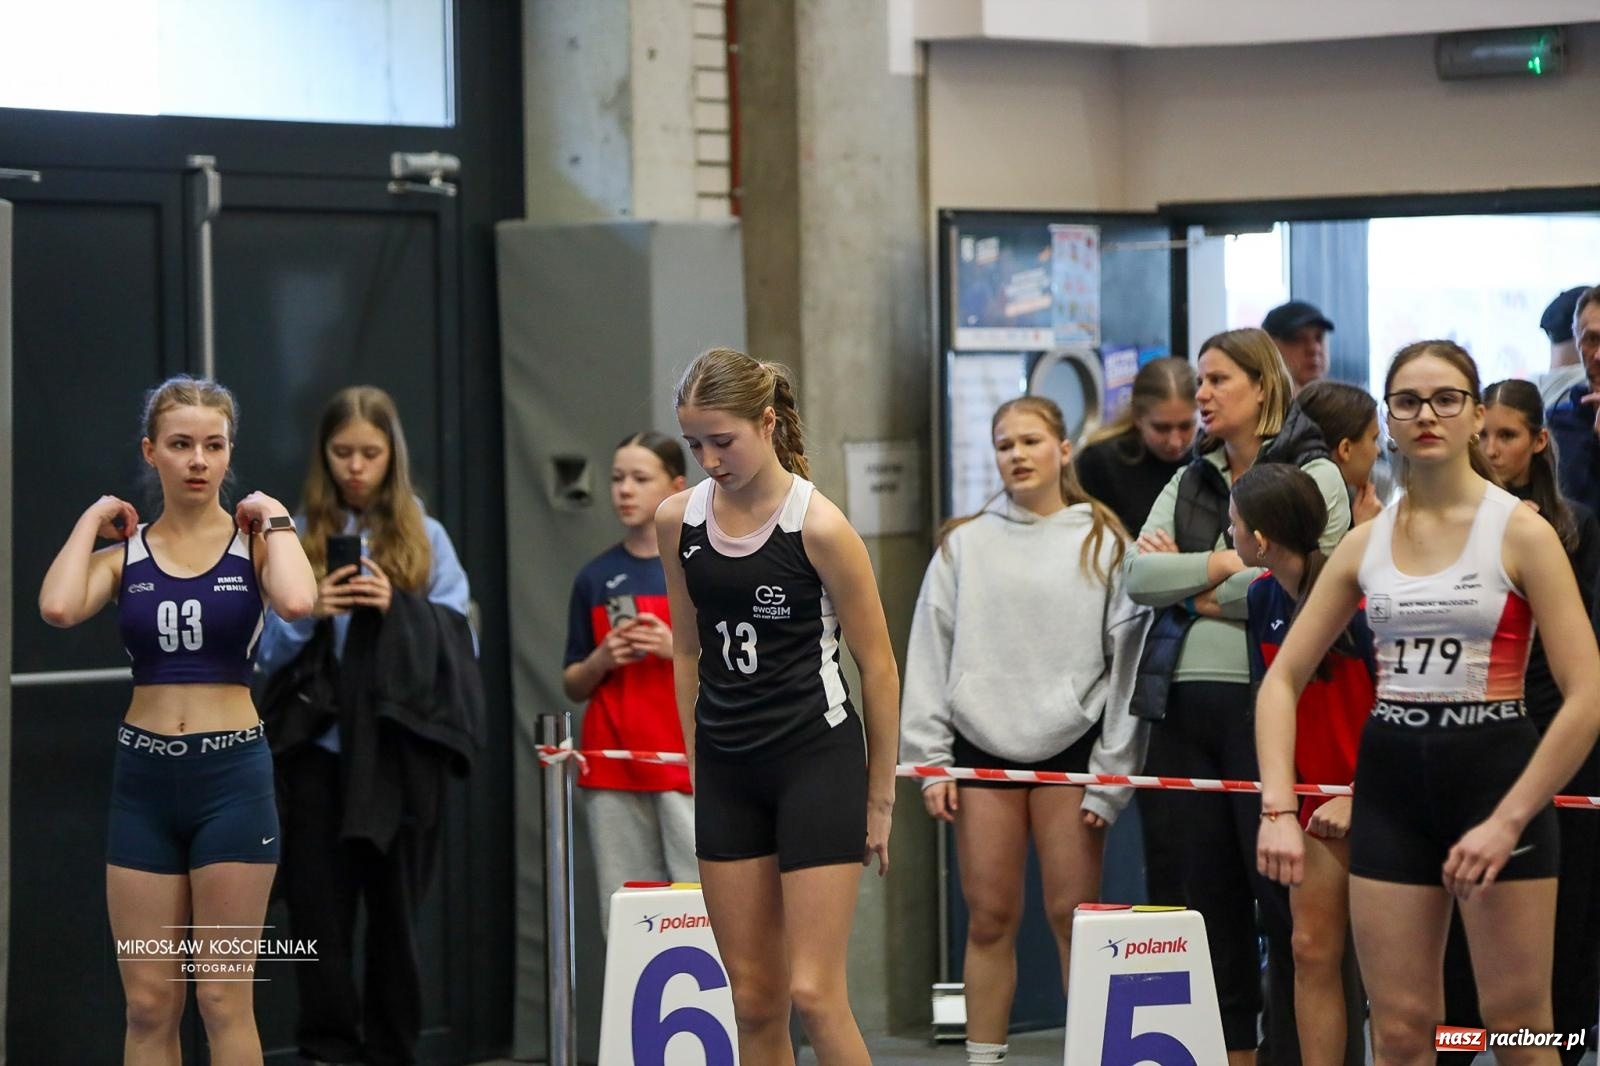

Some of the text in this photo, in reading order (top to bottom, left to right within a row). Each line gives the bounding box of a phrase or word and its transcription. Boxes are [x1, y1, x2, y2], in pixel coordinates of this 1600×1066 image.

[213, 584, 248, 592] RYBNIK
[157, 599, 203, 653] 93
[715, 620, 758, 675] 13
[1394, 637, 1463, 675] 179
[1372, 700, 1519, 727] PRO NIKE
[134, 734, 188, 756] PRO
[201, 728, 258, 753] NIKE
[1124, 936, 1188, 959] polanik
[631, 945, 735, 1066] 6
[1100, 970, 1199, 1066] 5
